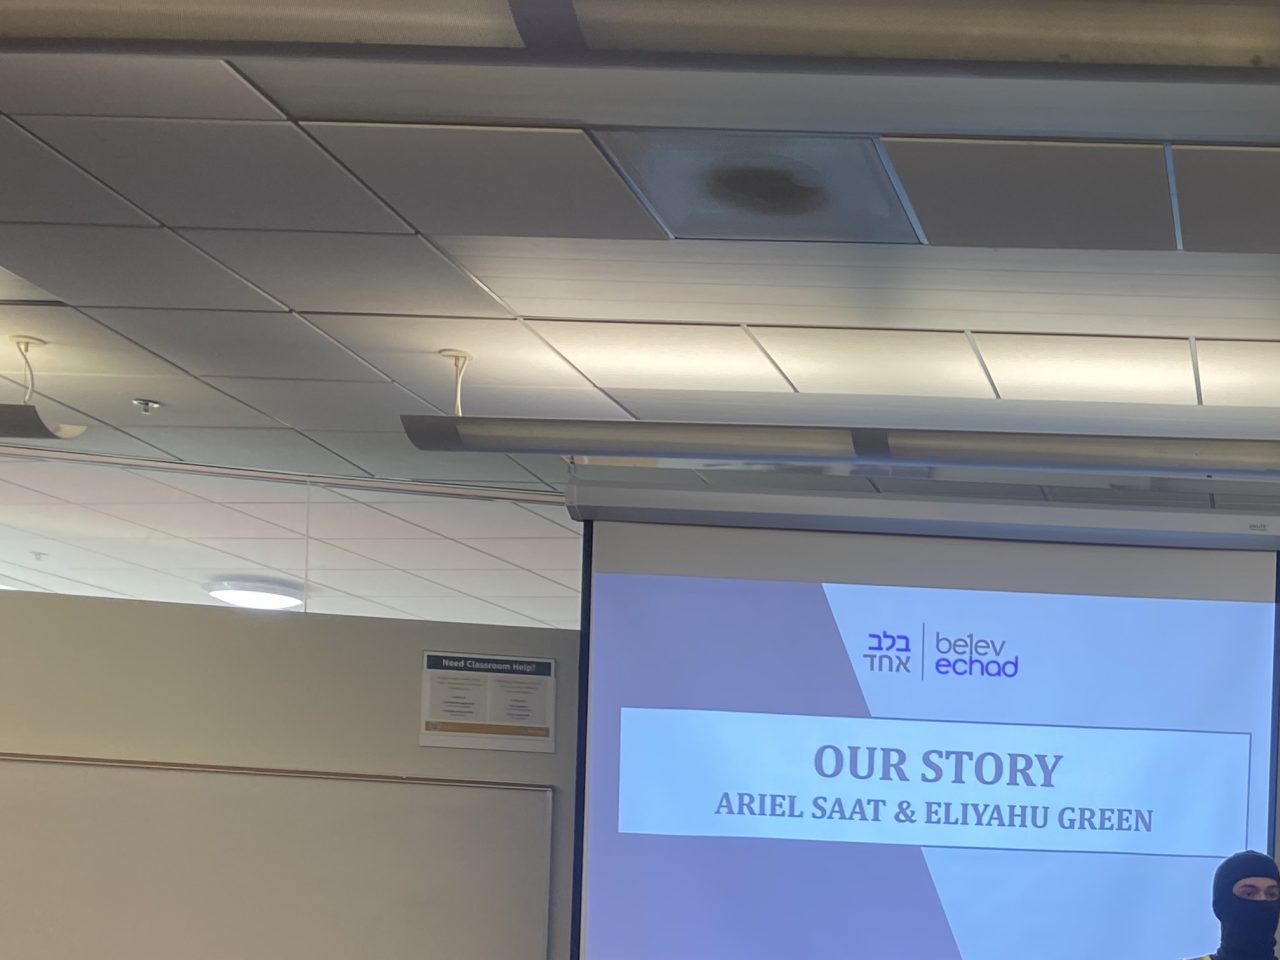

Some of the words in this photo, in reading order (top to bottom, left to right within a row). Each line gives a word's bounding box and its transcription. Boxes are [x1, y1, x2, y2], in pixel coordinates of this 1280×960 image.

[868, 630, 911, 652] בלב
[442, 659, 464, 668] Need
[466, 660, 511, 670] Classroom
[513, 663, 536, 672] Help?
[863, 653, 911, 673] אחד
[935, 655, 1019, 678] echad
[813, 744, 910, 783] OUR
[920, 749, 1064, 788] STORY
[714, 792, 804, 819] ARIEL
[811, 796, 887, 823] SAAT
[894, 800, 918, 824] &
[925, 801, 1051, 829] ELIYAHU
[1057, 806, 1154, 832] GREEN
